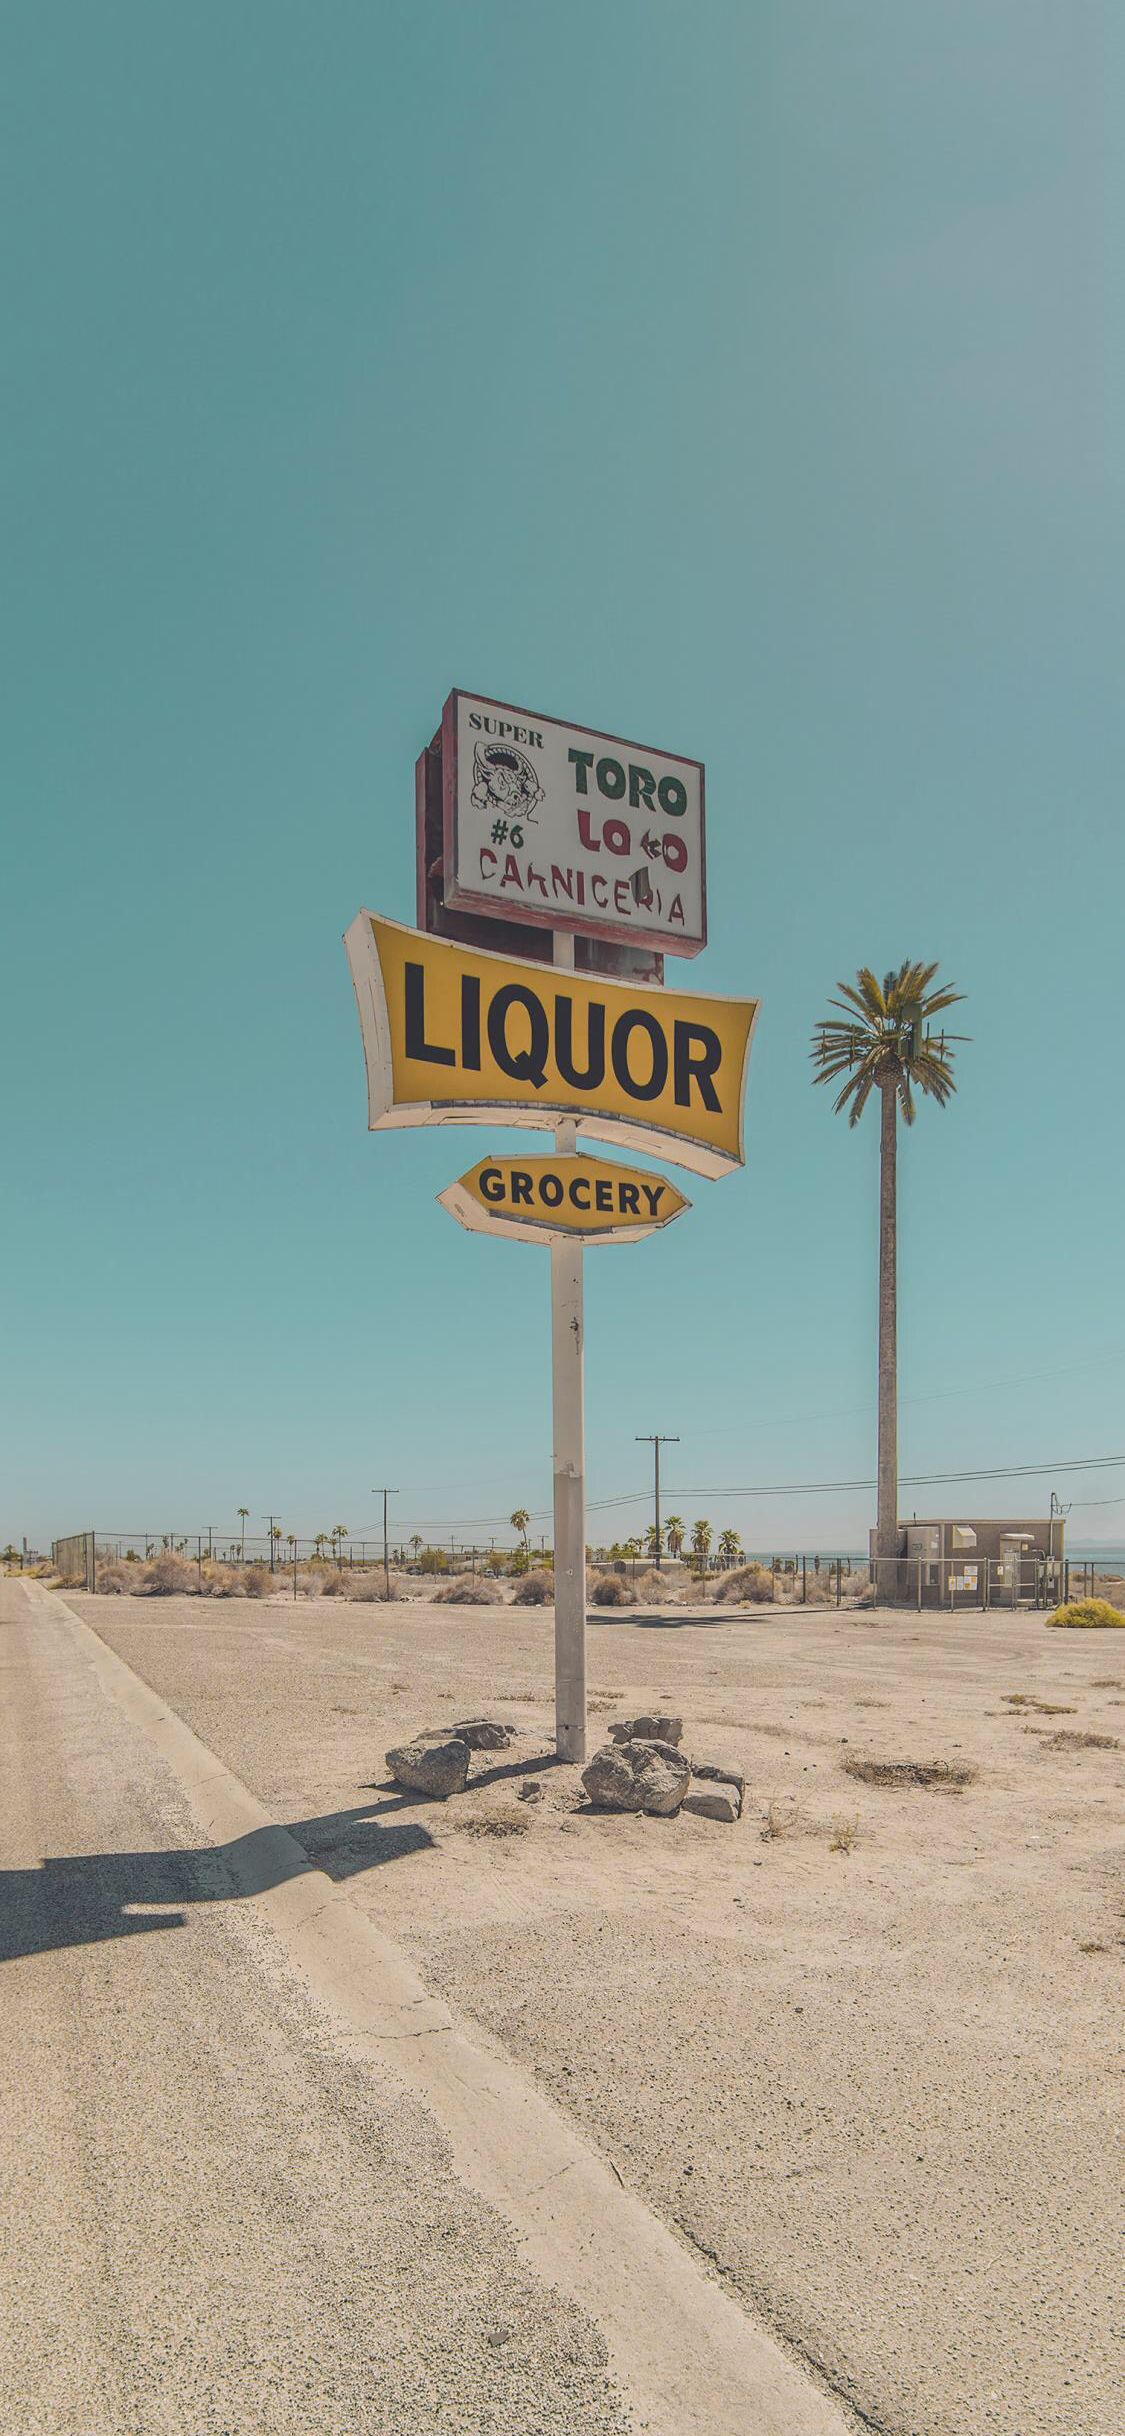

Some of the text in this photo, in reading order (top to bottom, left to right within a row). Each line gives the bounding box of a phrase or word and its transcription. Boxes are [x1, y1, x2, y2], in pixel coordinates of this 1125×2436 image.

[468, 712, 545, 749] SUPER
[567, 747, 688, 817] TORO
[490, 819, 525, 849] #6
[405, 962, 723, 1114] LIQUOR
[478, 1167, 666, 1217] GROCERY
